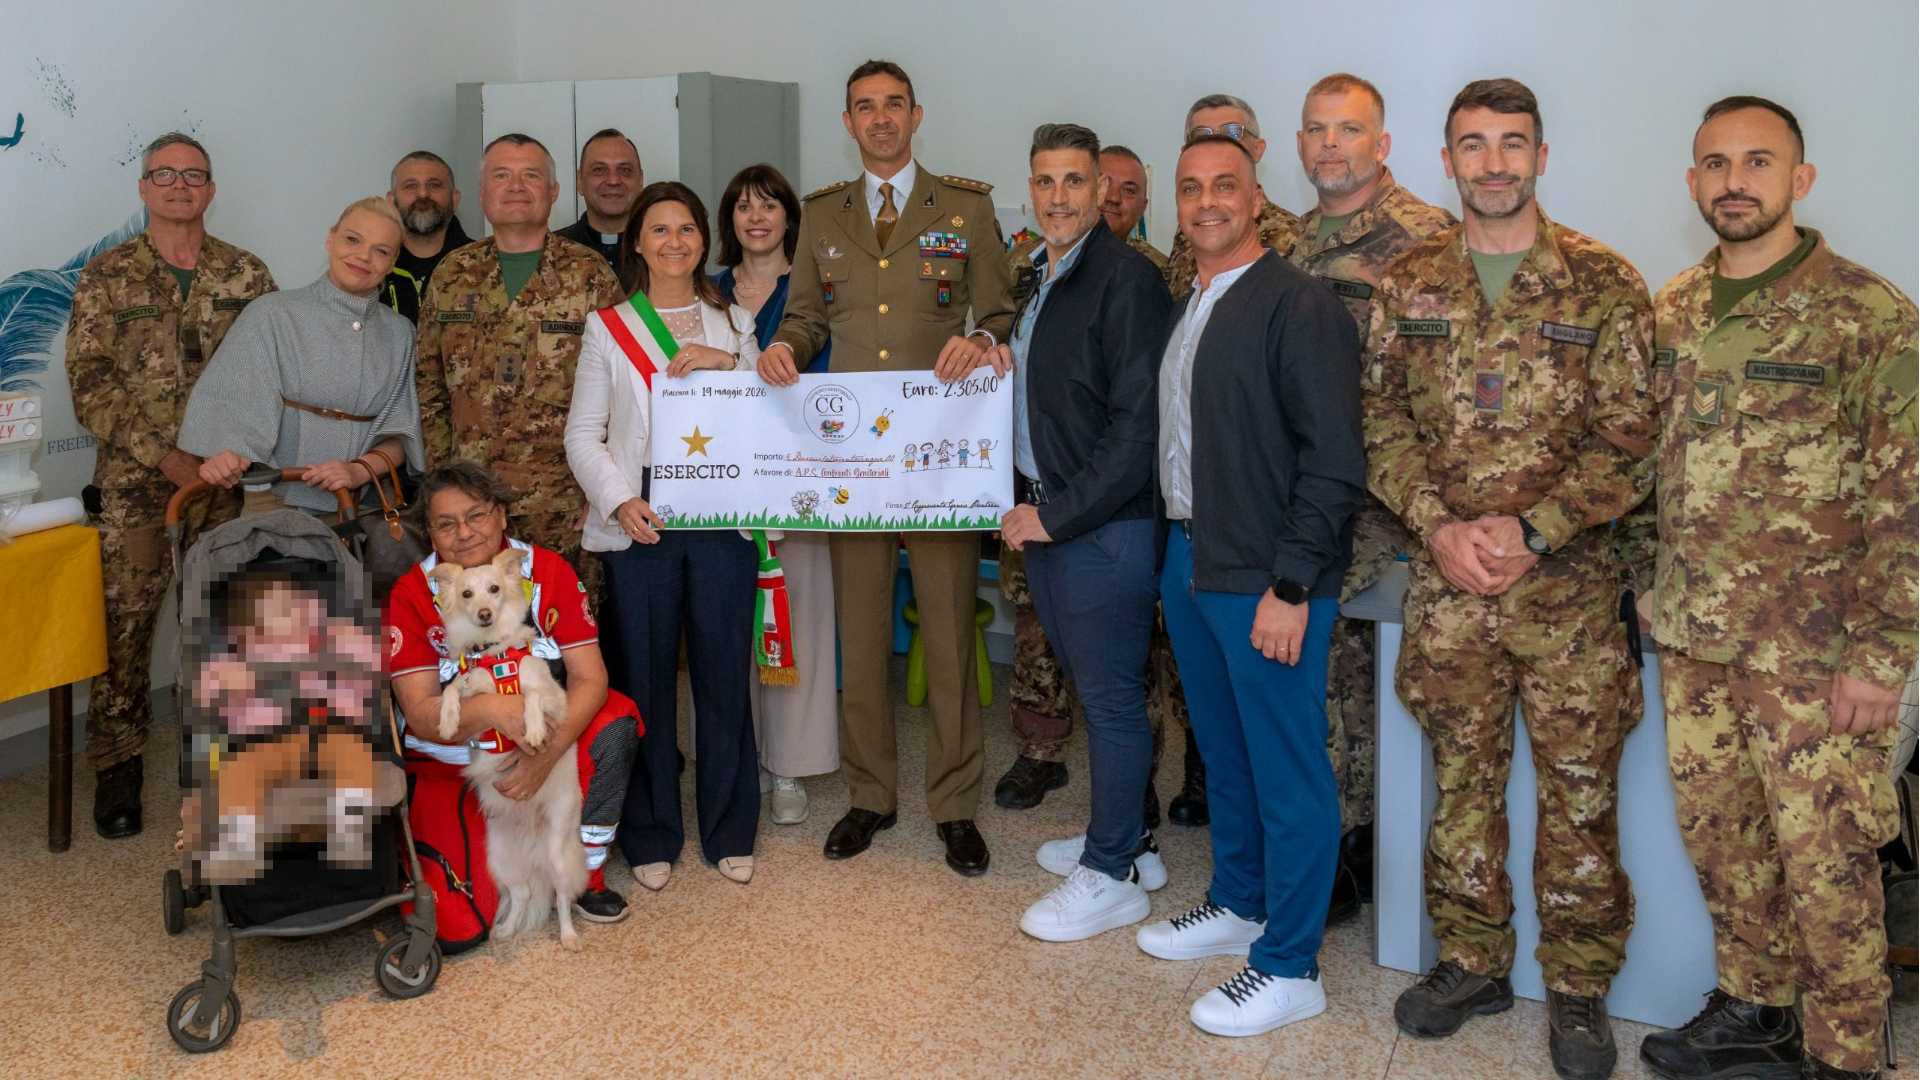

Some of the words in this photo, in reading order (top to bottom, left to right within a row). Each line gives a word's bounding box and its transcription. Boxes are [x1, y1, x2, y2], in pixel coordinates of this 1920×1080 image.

[702, 387, 712, 397] 19
[715, 387, 743, 399] maggio
[745, 387, 767, 397] 2026
[903, 382, 939, 399] Euro:
[816, 396, 843, 413] CG
[653, 464, 740, 479] ESERCITO
[761, 468, 782, 476] favore
